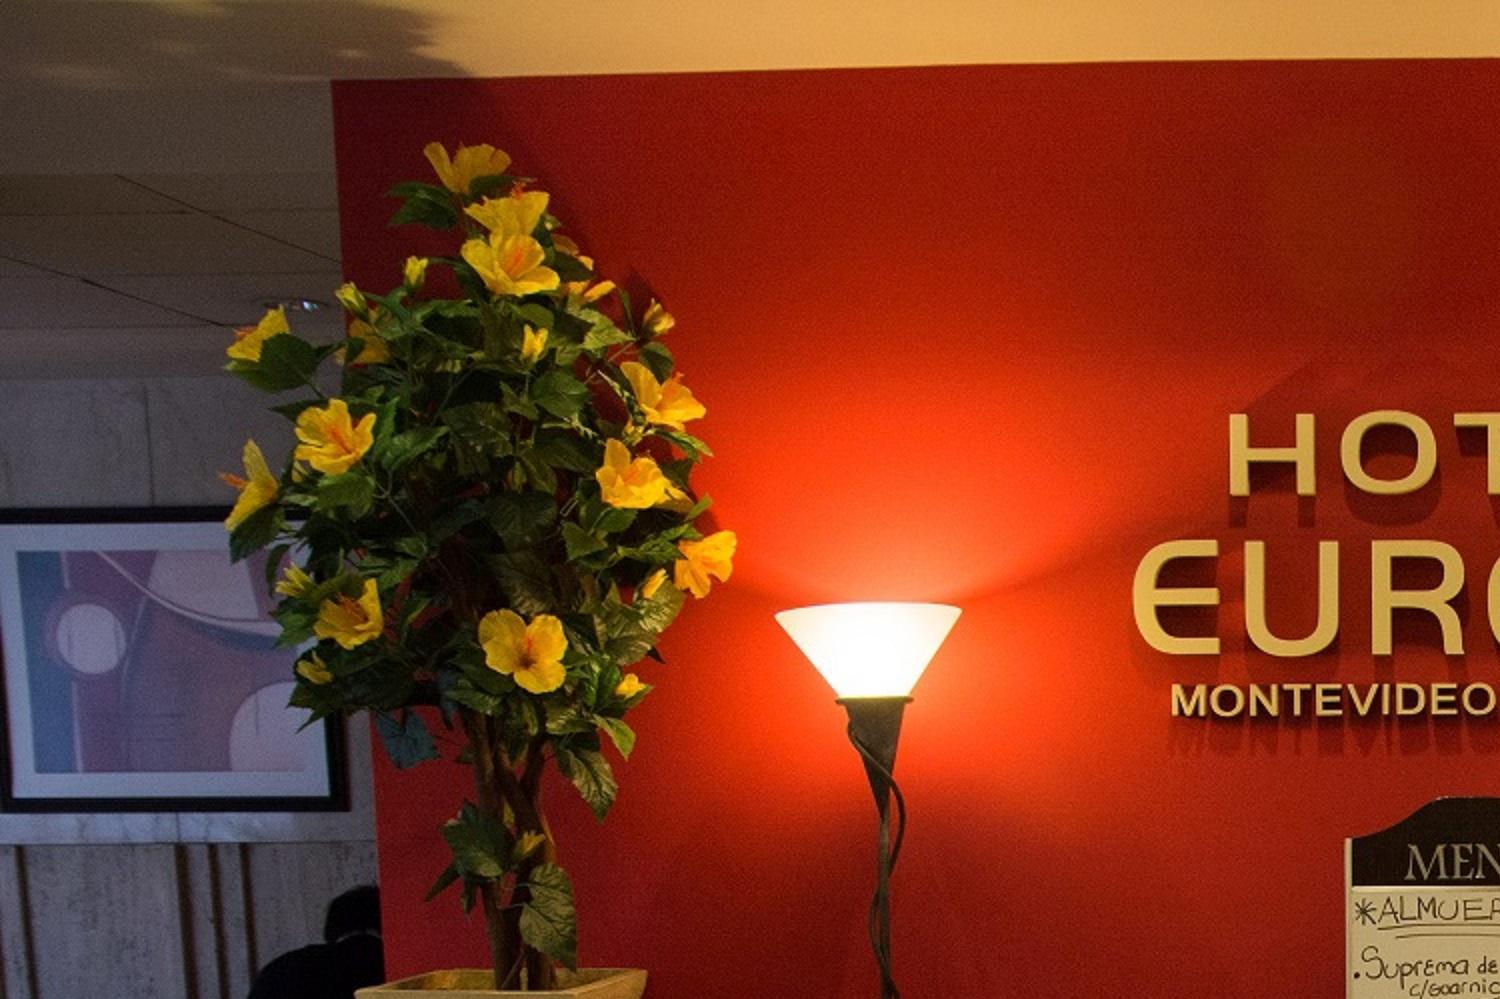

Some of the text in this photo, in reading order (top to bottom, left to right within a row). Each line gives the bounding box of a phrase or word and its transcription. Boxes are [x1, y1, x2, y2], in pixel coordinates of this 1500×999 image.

[1171, 683, 1497, 717] MONTEVIDEO
[1361, 945, 1469, 990] Suprema
[1477, 955, 1499, 975] de
